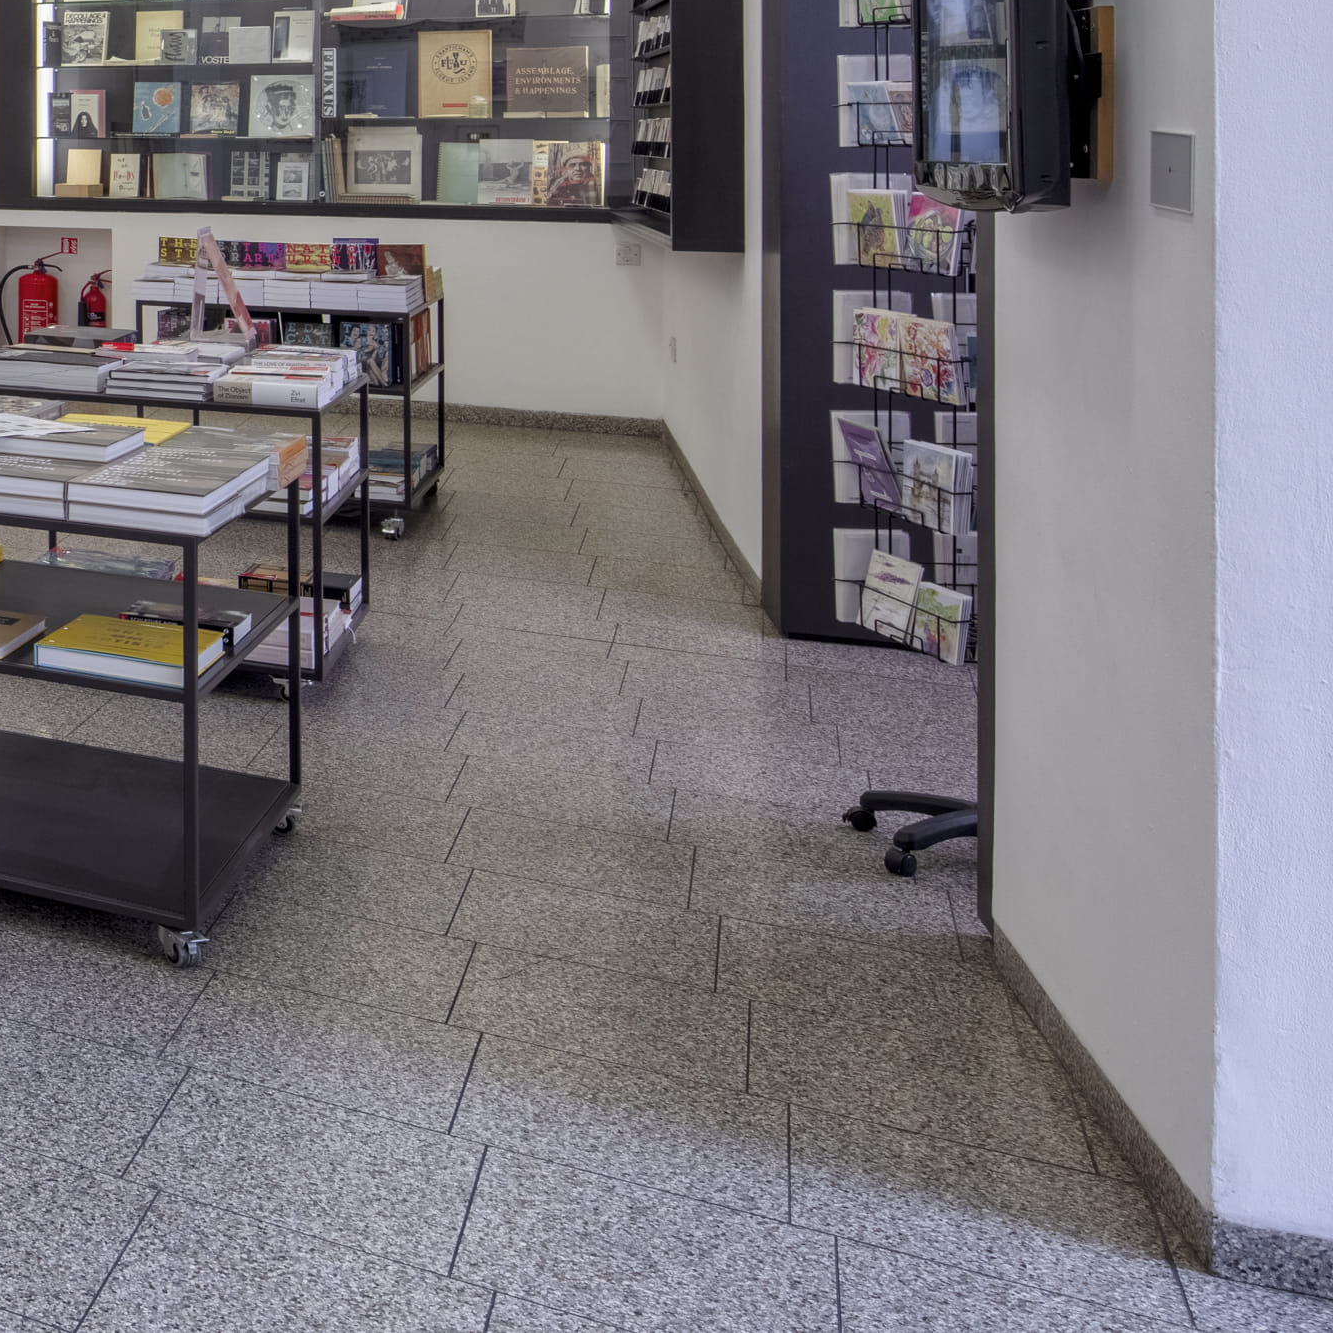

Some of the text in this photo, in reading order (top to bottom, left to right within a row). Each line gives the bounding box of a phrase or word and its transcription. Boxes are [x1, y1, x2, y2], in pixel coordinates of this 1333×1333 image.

[201, 56, 229, 64] VOSTE
[324, 50, 334, 116] FLUXUS
[515, 76, 582, 85] ENVIRONMENTS
[523, 86, 577, 95] HAPPENINGS
[230, 386, 251, 394] Object
